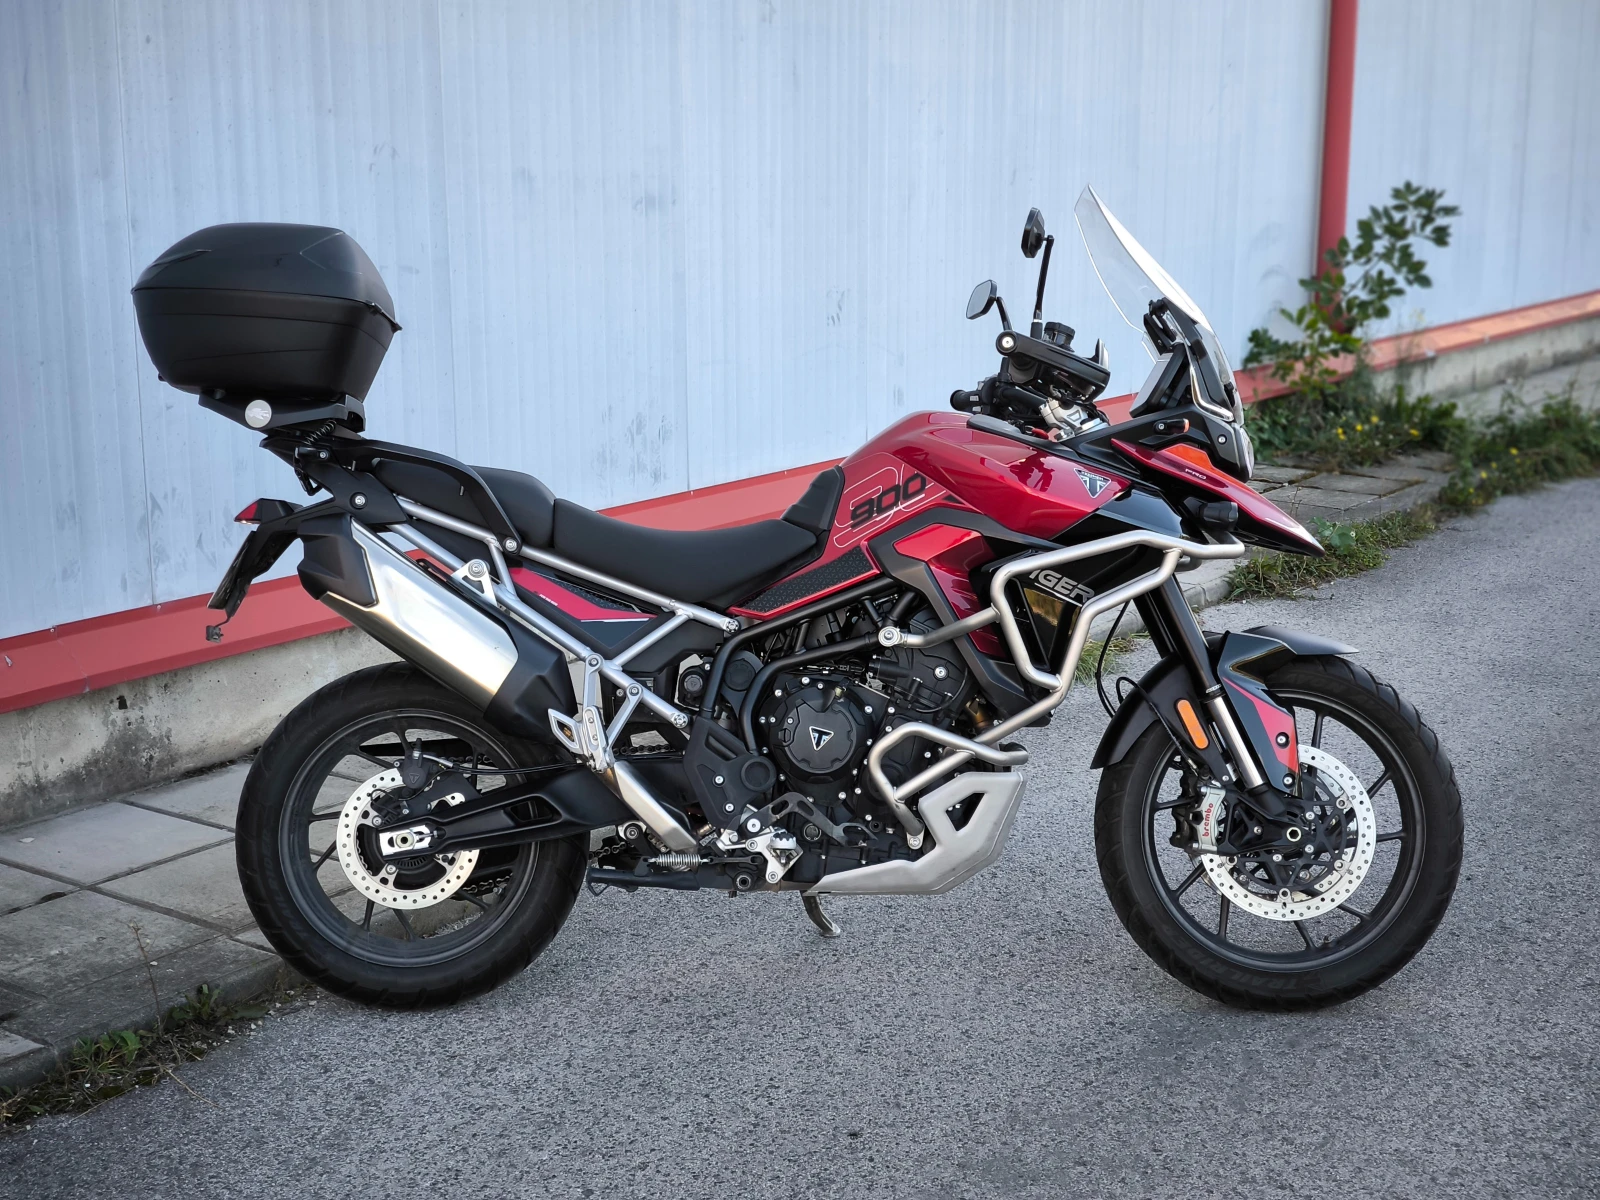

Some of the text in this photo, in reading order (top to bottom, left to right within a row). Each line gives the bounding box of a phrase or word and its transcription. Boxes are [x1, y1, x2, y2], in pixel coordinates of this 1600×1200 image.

[1184, 468, 1207, 480] PRO
[850, 472, 927, 529] 900
[1028, 569, 1095, 602] IGER
[1201, 802, 1214, 838] brembo
